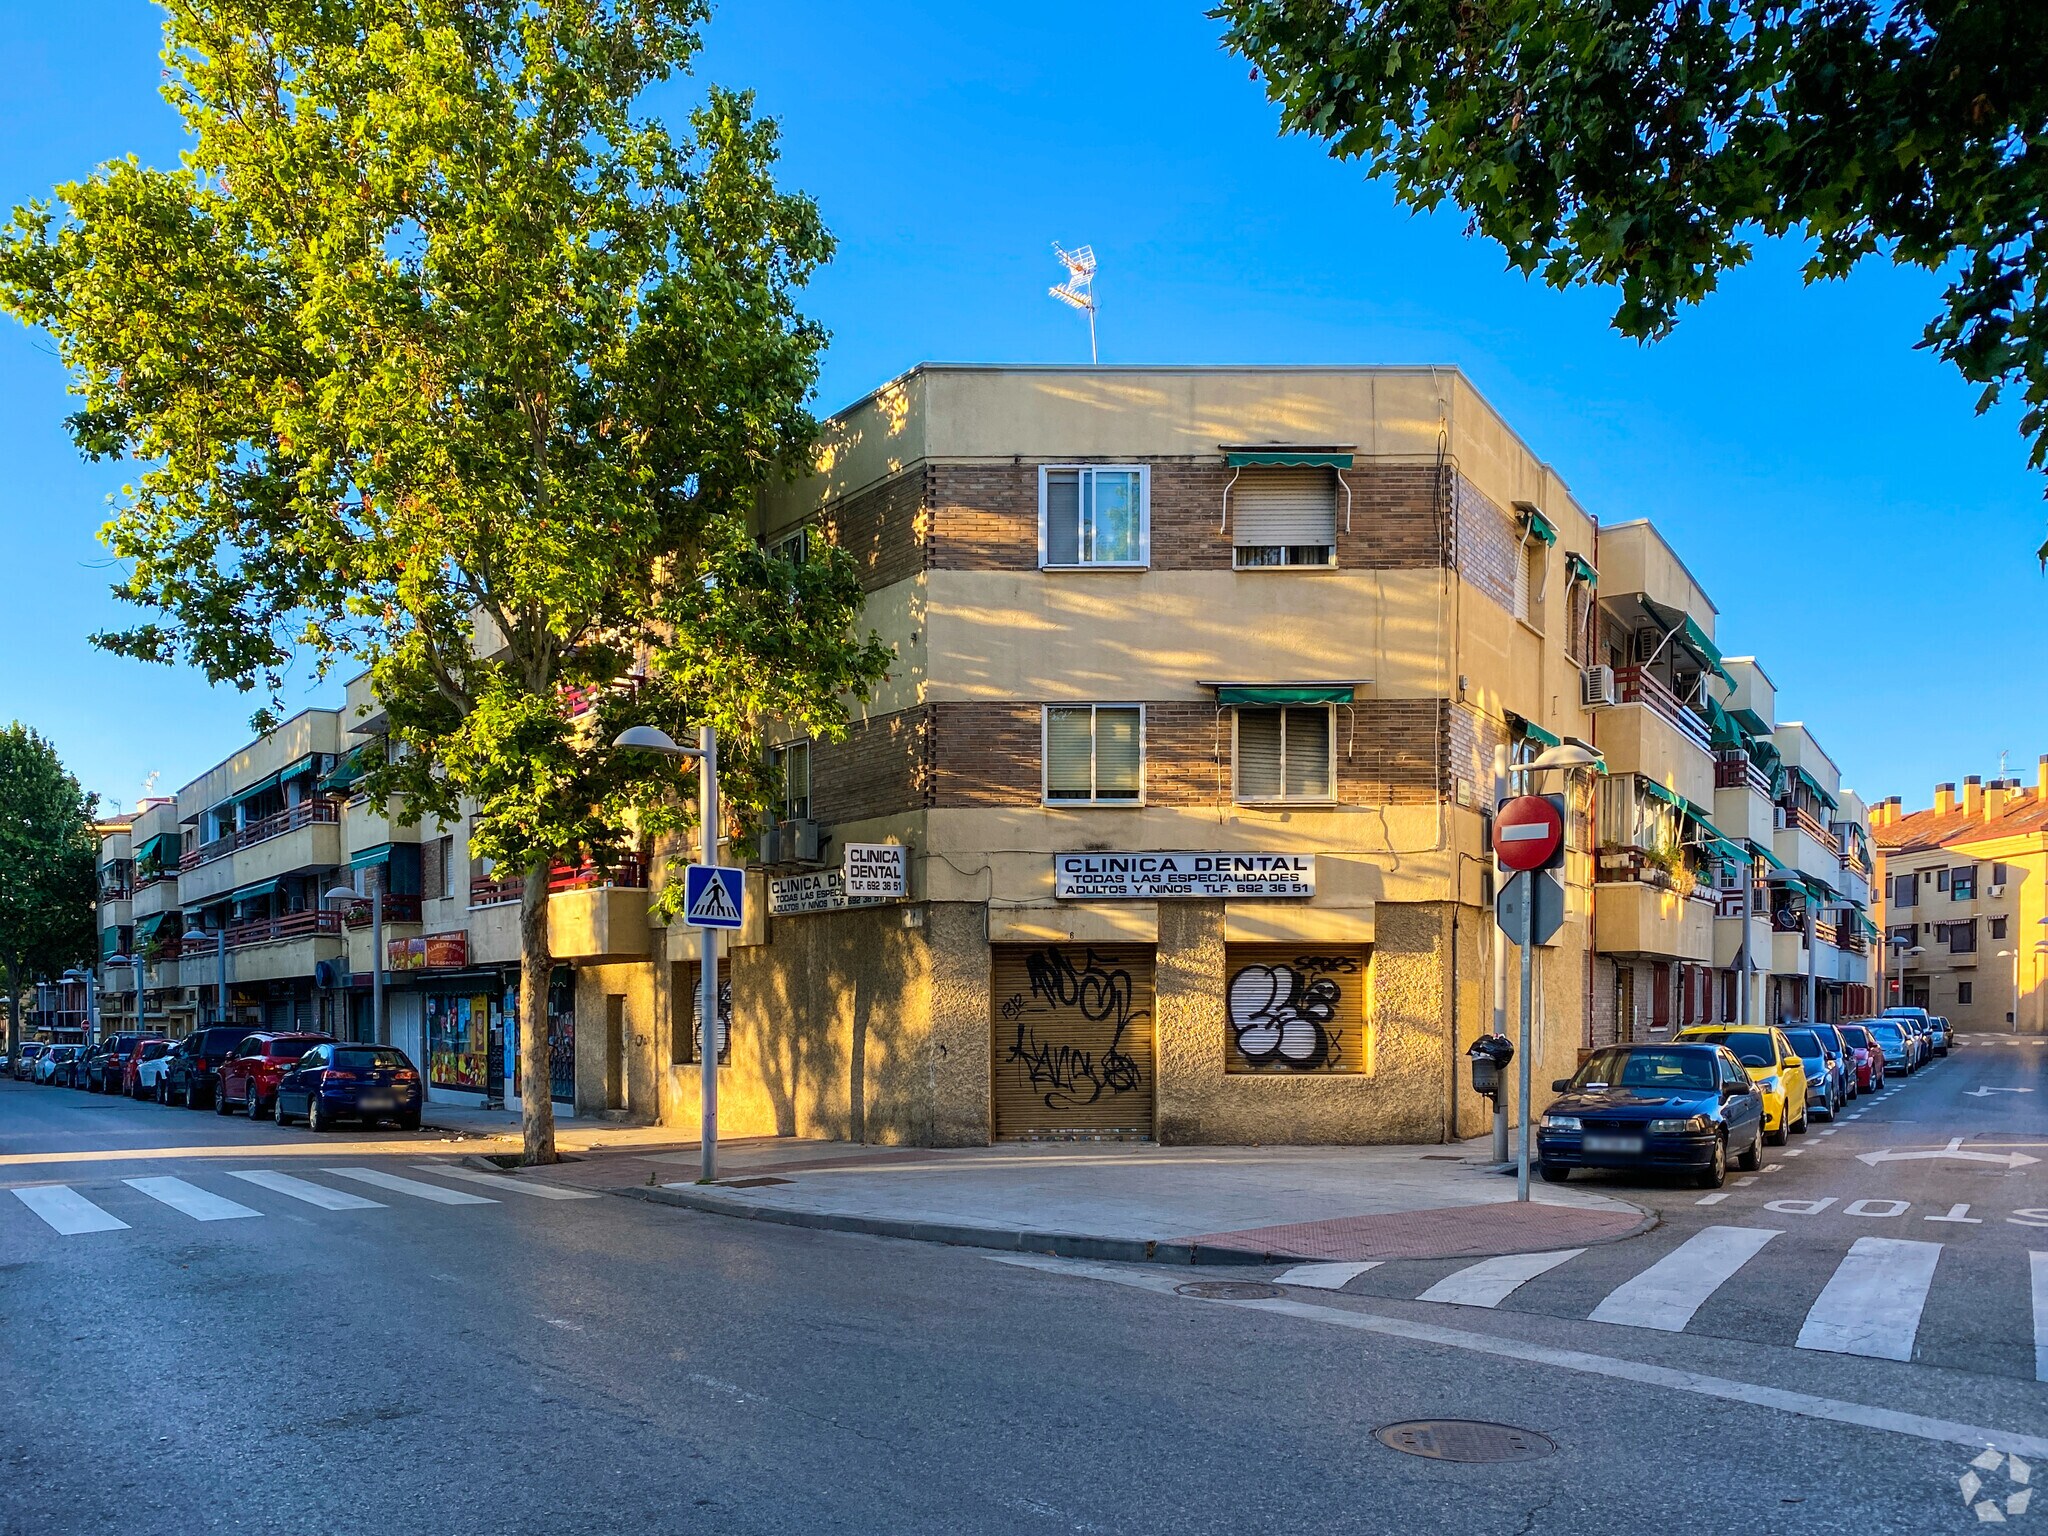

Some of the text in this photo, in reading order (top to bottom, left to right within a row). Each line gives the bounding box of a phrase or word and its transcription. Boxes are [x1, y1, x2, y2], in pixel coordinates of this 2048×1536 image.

[850, 849, 901, 863] CLINICA
[851, 865, 901, 878] DENTAL
[1064, 857, 1308, 873] CLINICA DENTAL
[772, 876, 821, 893] CLINICA
[1073, 873, 1300, 883] TODAS LAS ESPECIALIDADES
[851, 880, 902, 891] TLF. 692 36 51
[1065, 882, 1309, 894] ADULTOS Y NIÑOS TLF. 692 36 51
[775, 893, 799, 903] TODAS
[800, 891, 815, 901] LAS
[772, 902, 799, 913] ADULTOS
[801, 901, 807, 910] Y
[808, 899, 828, 909] NIÑOS
